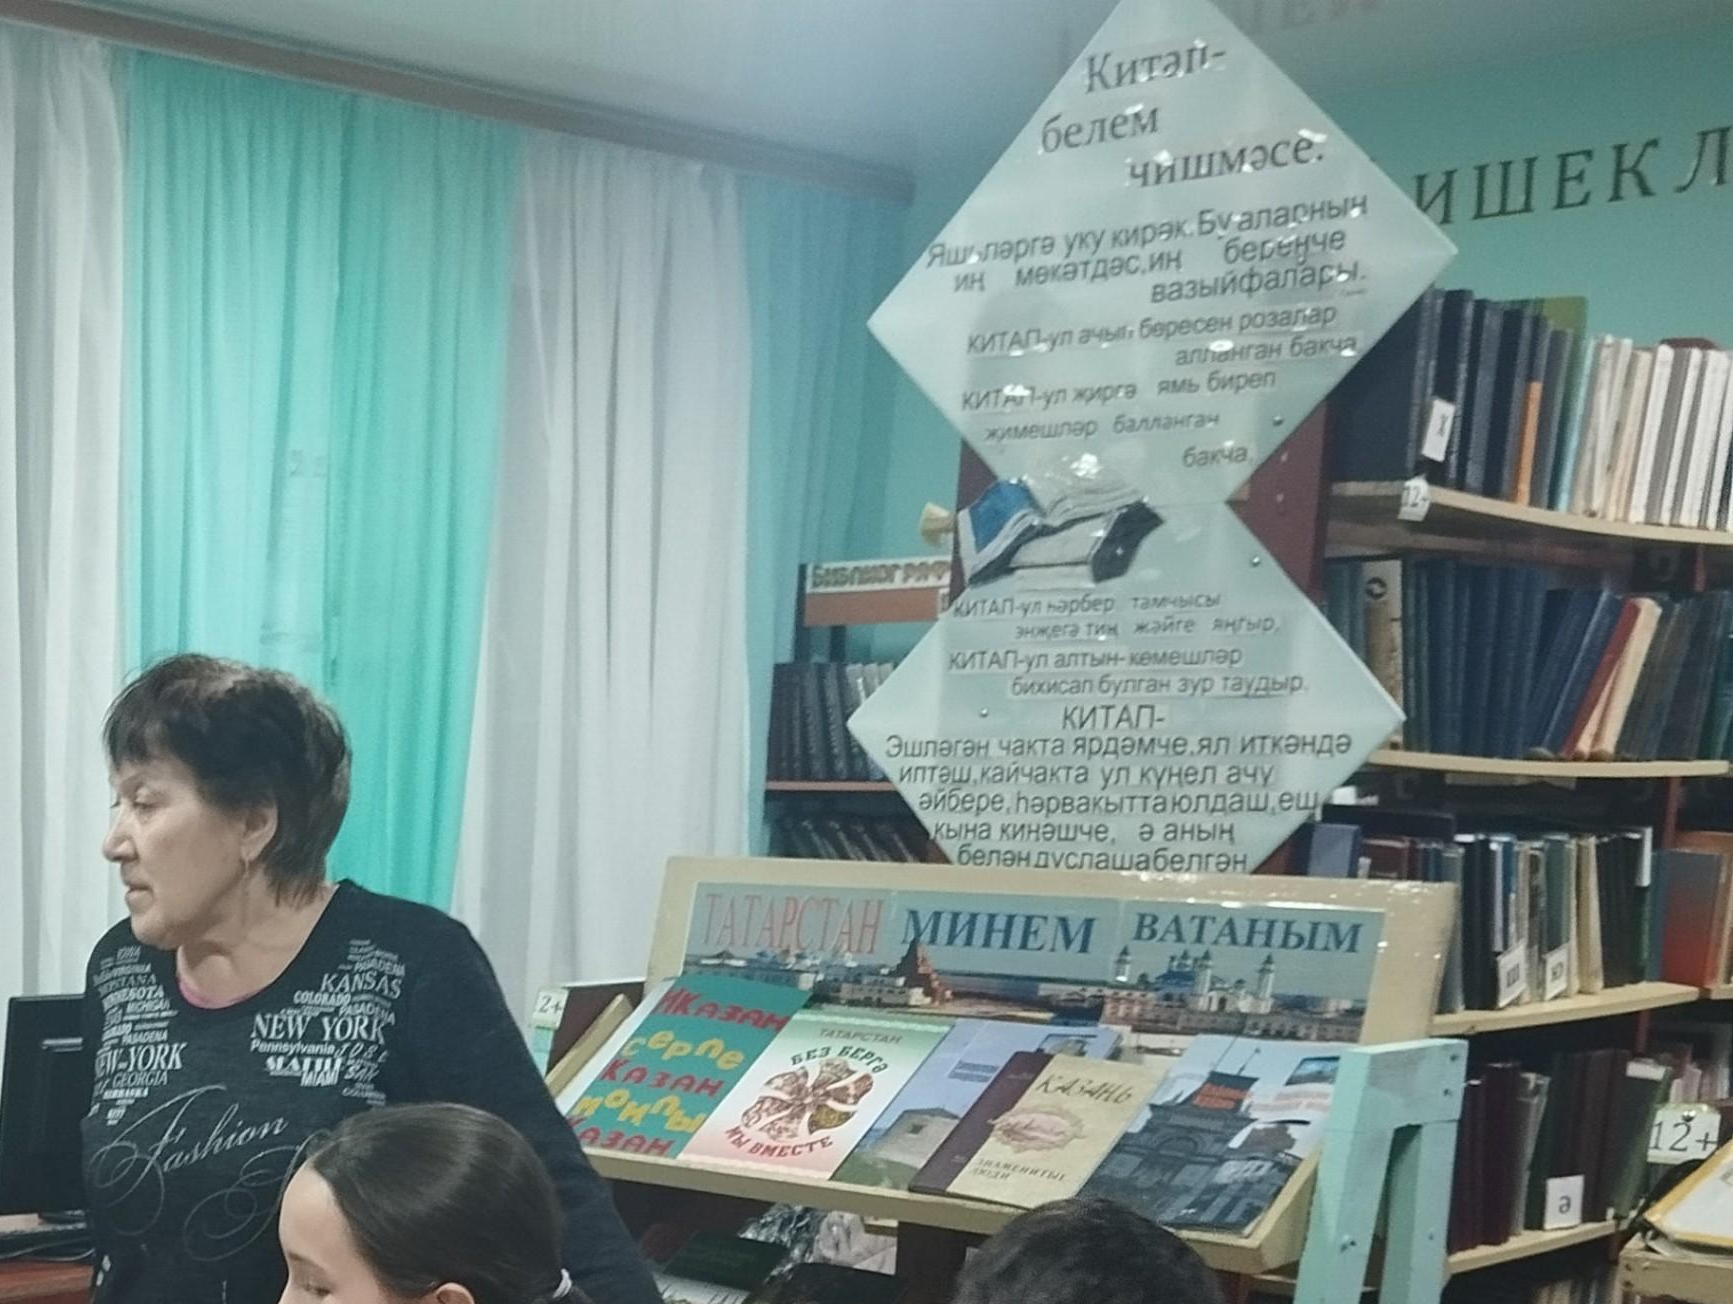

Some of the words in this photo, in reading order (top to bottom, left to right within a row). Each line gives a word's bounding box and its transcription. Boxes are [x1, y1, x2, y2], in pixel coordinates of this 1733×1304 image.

[1041, 106, 1160, 153] белем
[1064, 230, 1106, 258] уку
[1205, 369, 1277, 394] биреп
[1097, 673, 1172, 699] булган
[1176, 676, 1215, 697] зур
[1061, 703, 1166, 731] КИТАП-
[885, 734, 990, 758] Эшләгән
[997, 736, 1065, 756] чакта
[1238, 732, 1354, 760] иткәндә
[1100, 764, 1131, 791] ул
[933, 821, 992, 840] кына
[1138, 824, 1155, 842] ә
[1163, 823, 1236, 845] аның
[700, 892, 884, 954] ТАТАРСТАН
[900, 907, 1097, 955] МИНЕМ
[1133, 911, 1362, 954] ВАТАНЫМ
[320, 970, 404, 999] KANSAS
[250, 1012, 312, 1040] NEW
[321, 1014, 386, 1046] YORK
[819, 1027, 903, 1045] ТАТАРСТАН
[250, 1038, 336, 1056] Pennsylvania
[790, 1046, 832, 1066] БЕЗ
[837, 1045, 889, 1074] БЕРГӘ
[600, 1058, 724, 1098] КАЗАН
[1035, 1073, 1133, 1104] КАЗАНЬ
[751, 1135, 834, 1158] ВМЕСТЕ
[1648, 1120, 1718, 1153] 12+
